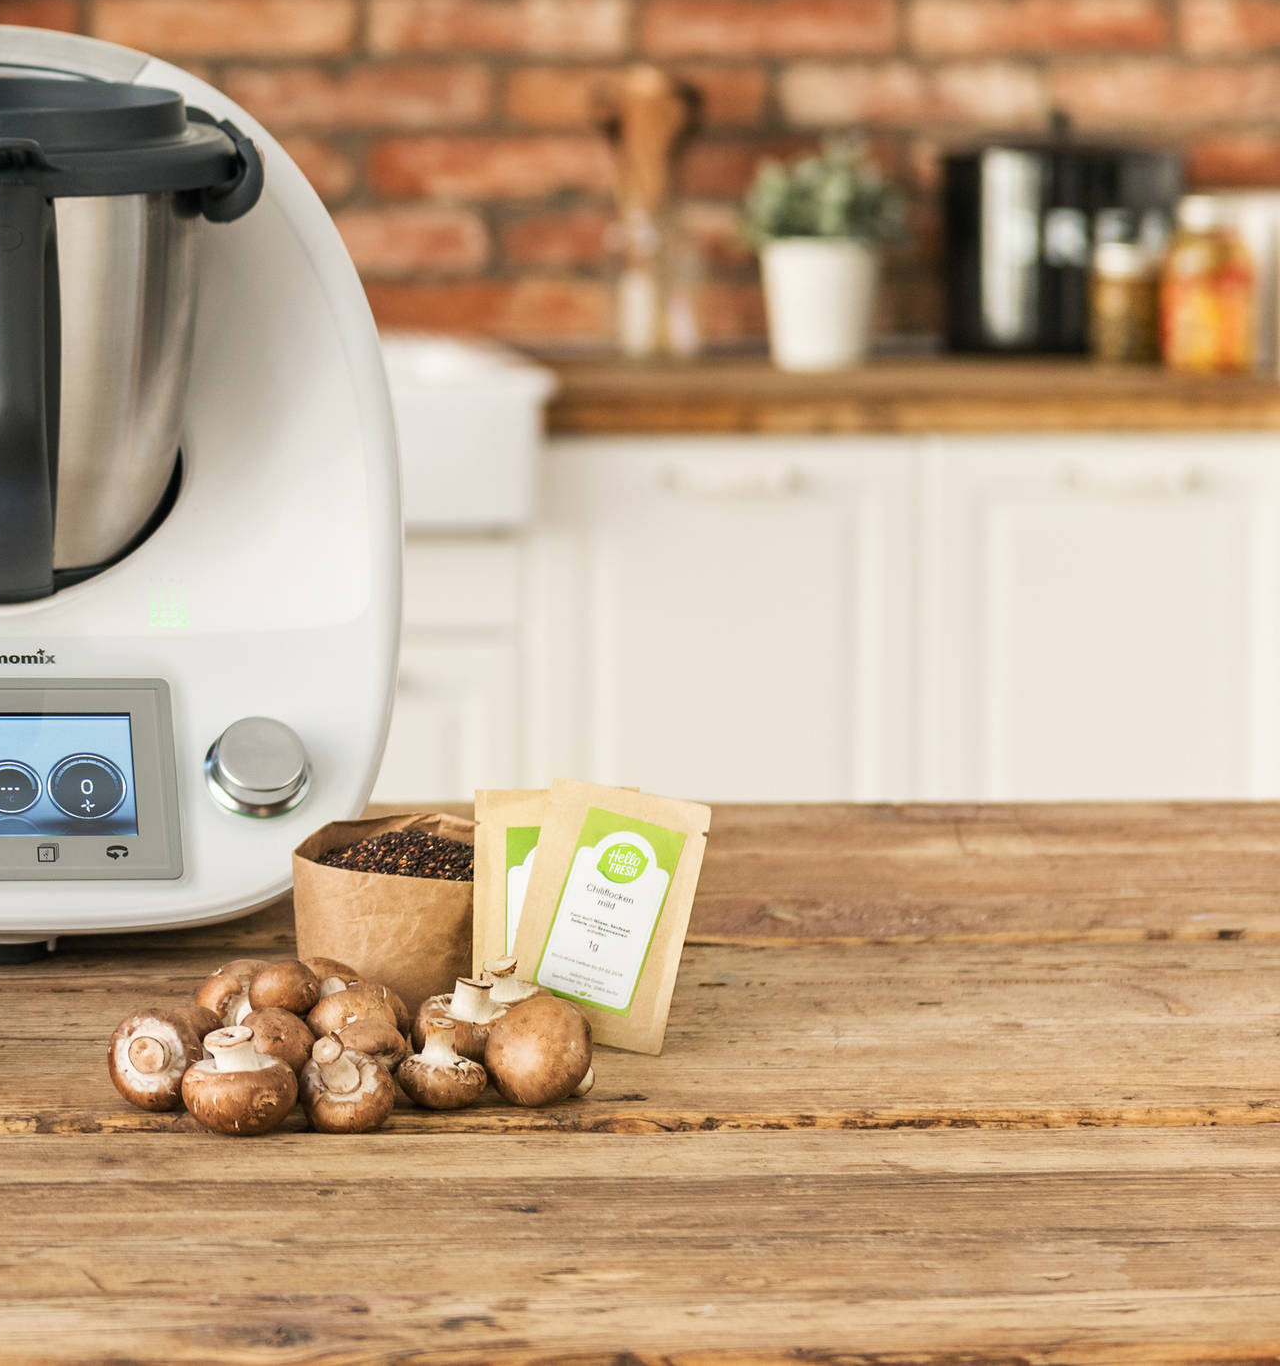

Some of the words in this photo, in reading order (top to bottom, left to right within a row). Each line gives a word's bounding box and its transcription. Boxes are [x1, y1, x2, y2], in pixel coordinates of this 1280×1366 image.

[80, 779, 94, 795] 0
[607, 848, 641, 867] Hello
[608, 862, 638, 878] FRESH
[597, 899, 616, 910] mild
[588, 940, 600, 953] 1g
